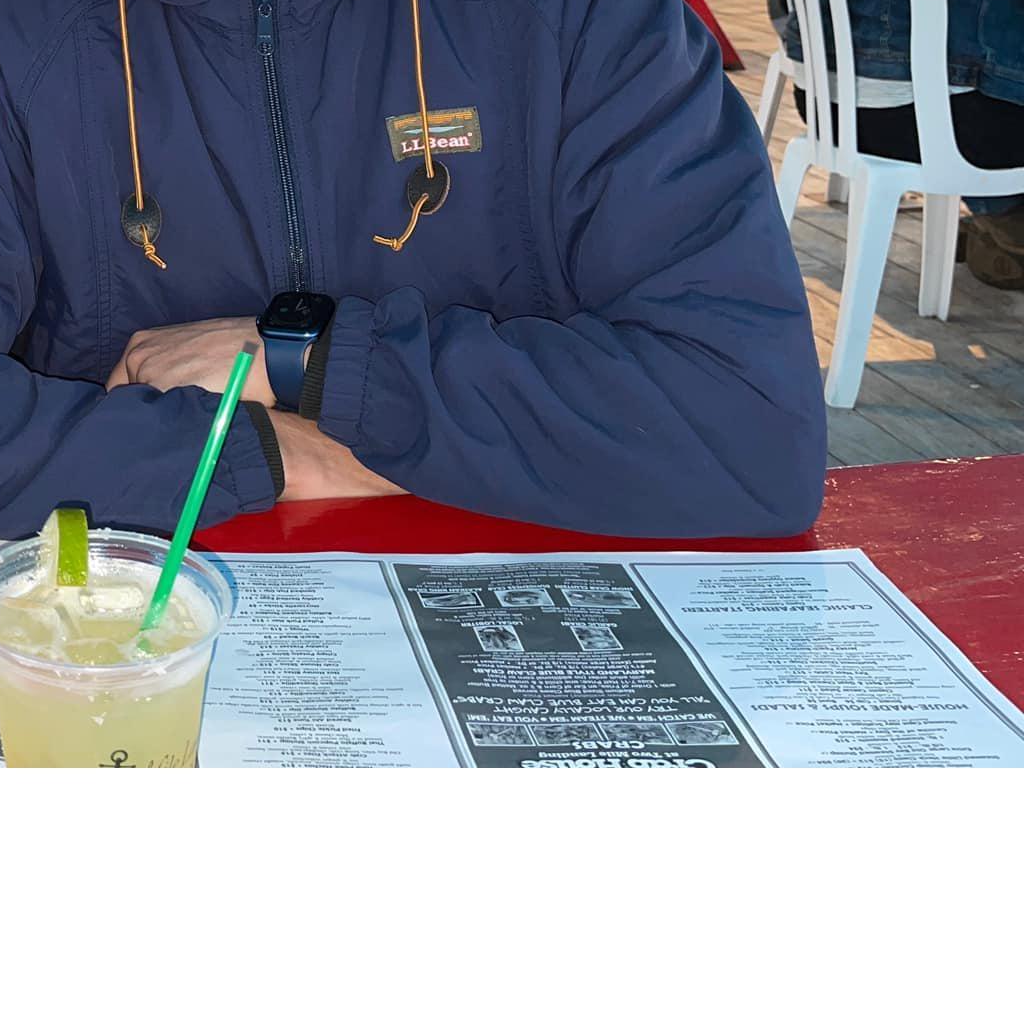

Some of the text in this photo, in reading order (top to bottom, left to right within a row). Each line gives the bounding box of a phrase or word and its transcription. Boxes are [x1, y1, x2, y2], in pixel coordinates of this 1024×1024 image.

[744, 604, 820, 612] SEAFARING
[546, 698, 582, 706] BLUE
[493, 706, 549, 714] CAUGHT
[553, 706, 612, 714] LOCALLY
[613, 705, 643, 713] OUR
[870, 703, 968, 711] HOUSE-MADE
[571, 740, 645, 749] CRABS
[521, 759, 624, 768] House
